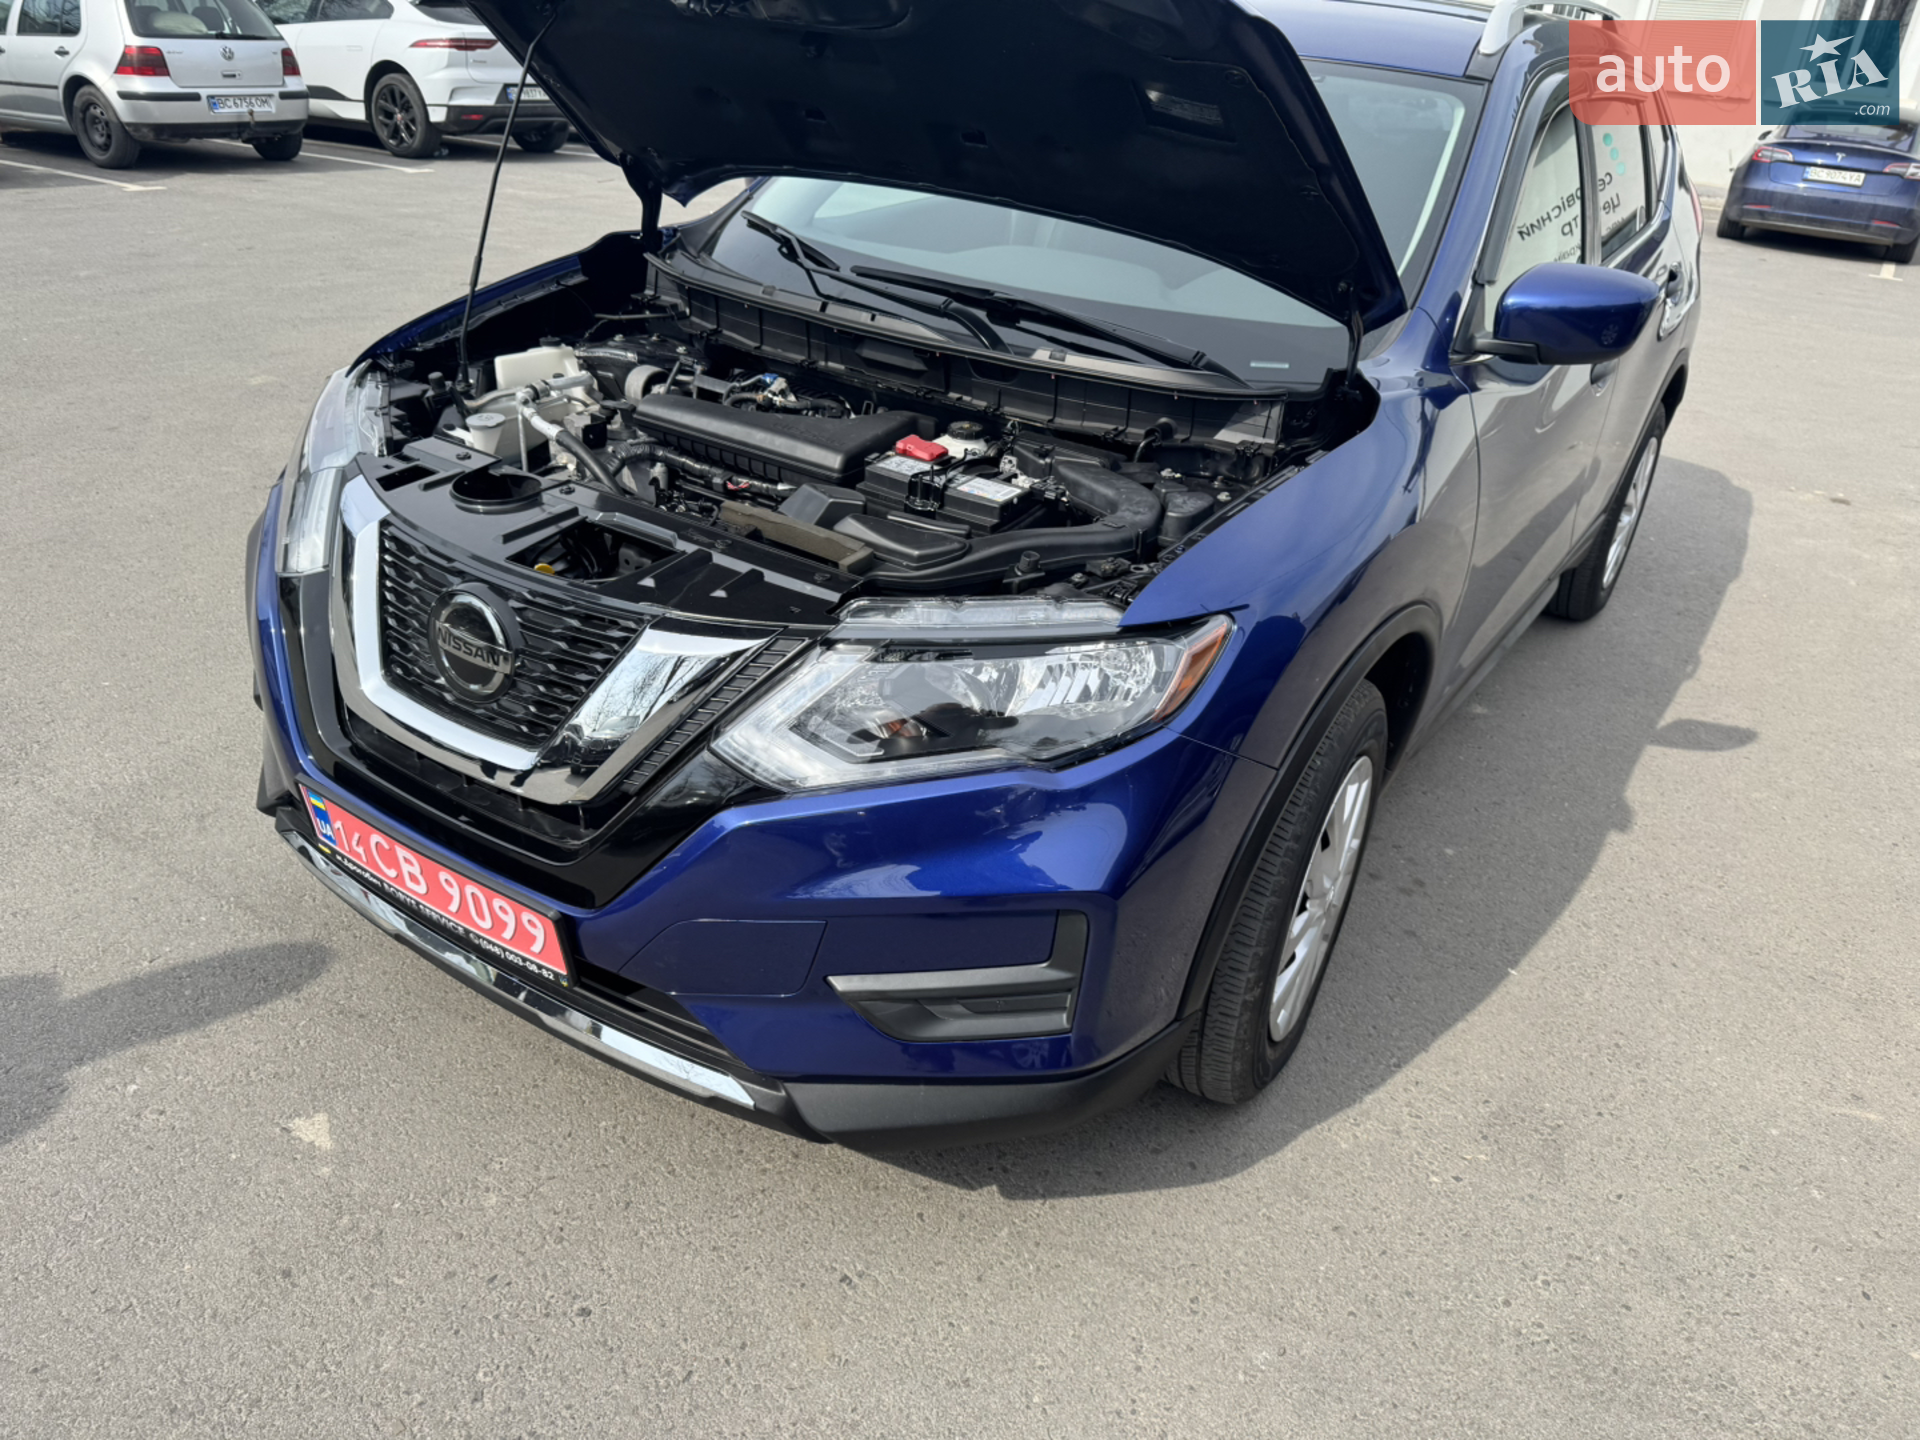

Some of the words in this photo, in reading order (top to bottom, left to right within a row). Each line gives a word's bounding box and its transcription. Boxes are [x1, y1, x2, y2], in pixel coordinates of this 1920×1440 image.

[437, 625, 501, 667] NISSAN
[318, 817, 335, 841] UA
[438, 871, 546, 954] 9099
